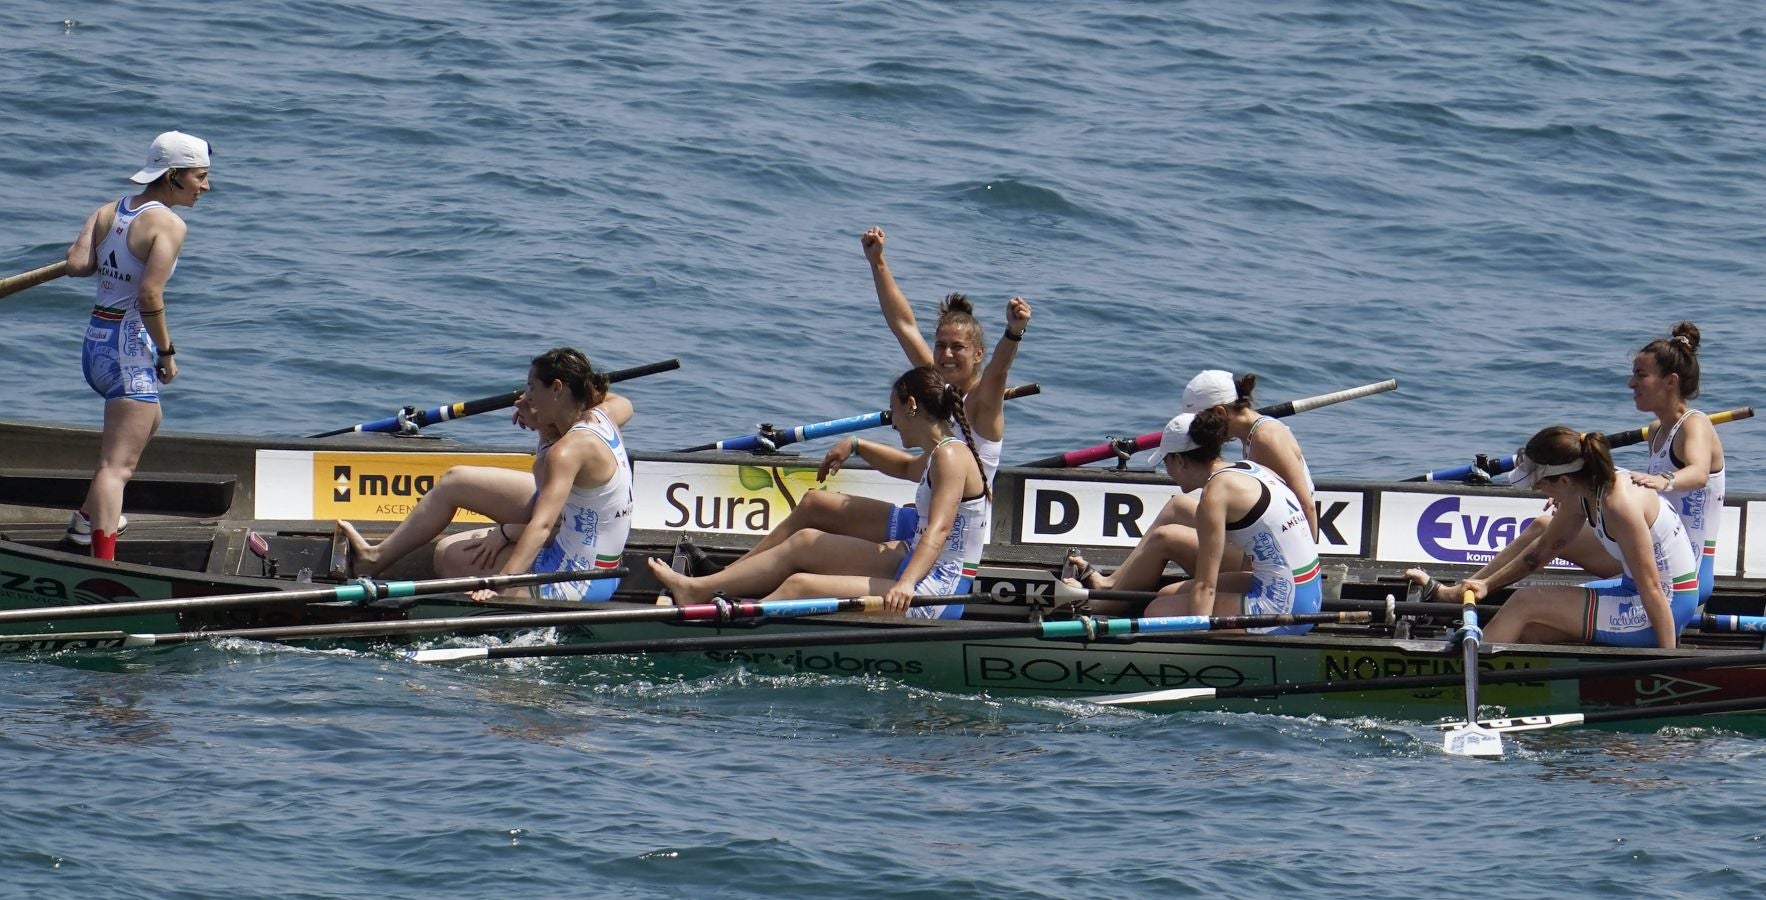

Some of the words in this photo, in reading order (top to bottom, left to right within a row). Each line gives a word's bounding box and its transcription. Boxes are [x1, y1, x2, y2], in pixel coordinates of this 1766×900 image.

[376, 504, 414, 514] ASCEN
[665, 482, 770, 530] Sura
[1034, 489, 1350, 545] DRK
[980, 656, 1244, 688] BOKADO
